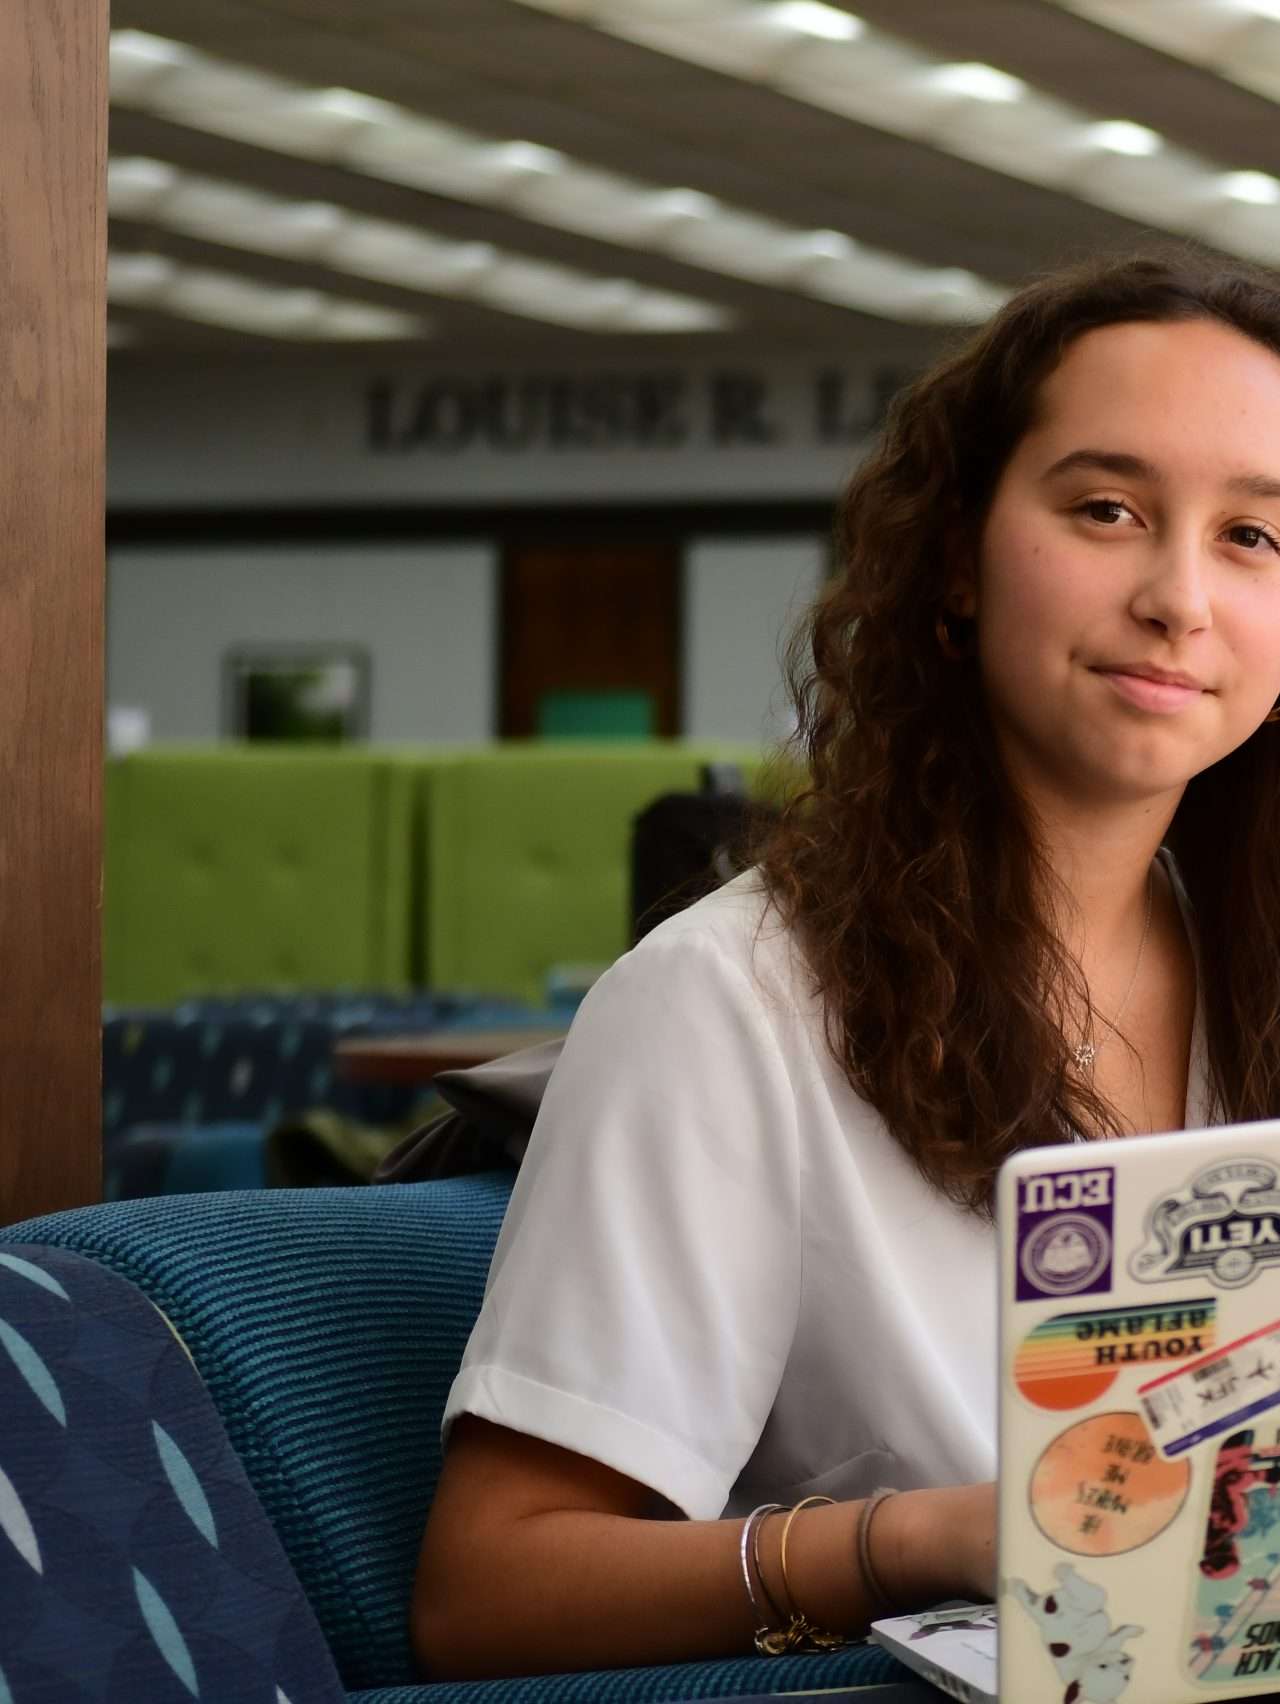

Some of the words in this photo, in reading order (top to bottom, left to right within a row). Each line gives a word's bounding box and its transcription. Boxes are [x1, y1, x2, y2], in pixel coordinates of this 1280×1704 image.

[1023, 1169, 1111, 1213] ECU
[1189, 1219, 1280, 1250] YETI
[1096, 1335, 1204, 1365] YOUTH
[1195, 1375, 1241, 1405] JFK
